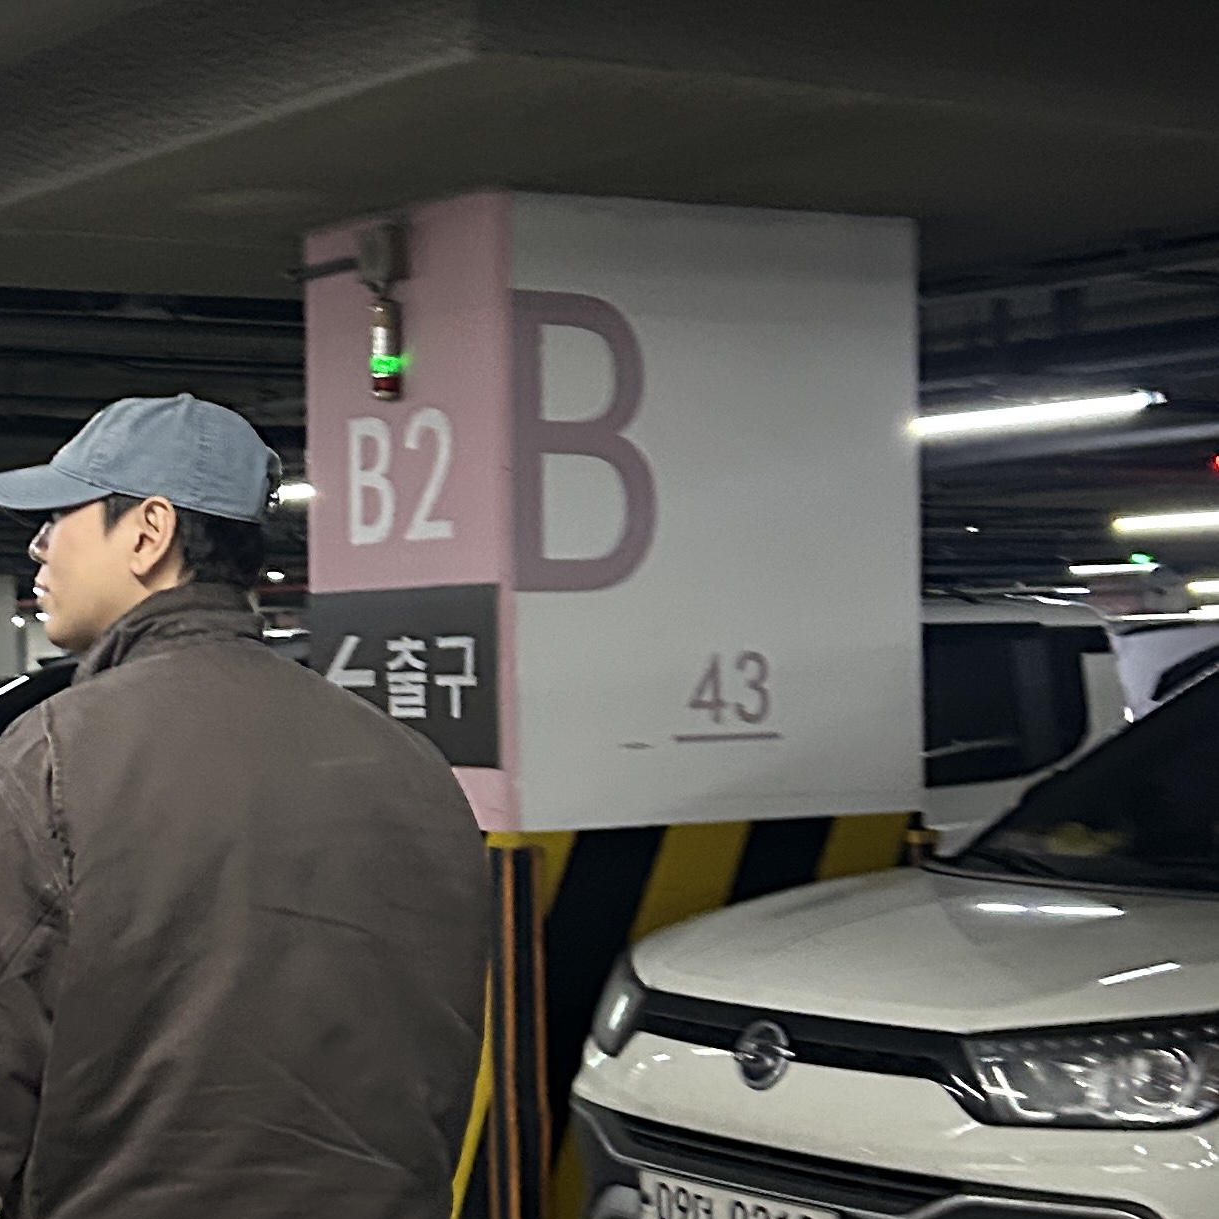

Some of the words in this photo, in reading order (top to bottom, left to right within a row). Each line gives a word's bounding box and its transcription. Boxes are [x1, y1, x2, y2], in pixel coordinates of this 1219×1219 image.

[348, 407, 454, 546] B2
[510, 288, 659, 592] B
[386, 635, 479, 719] 출구
[688, 650, 771, 724] 43
